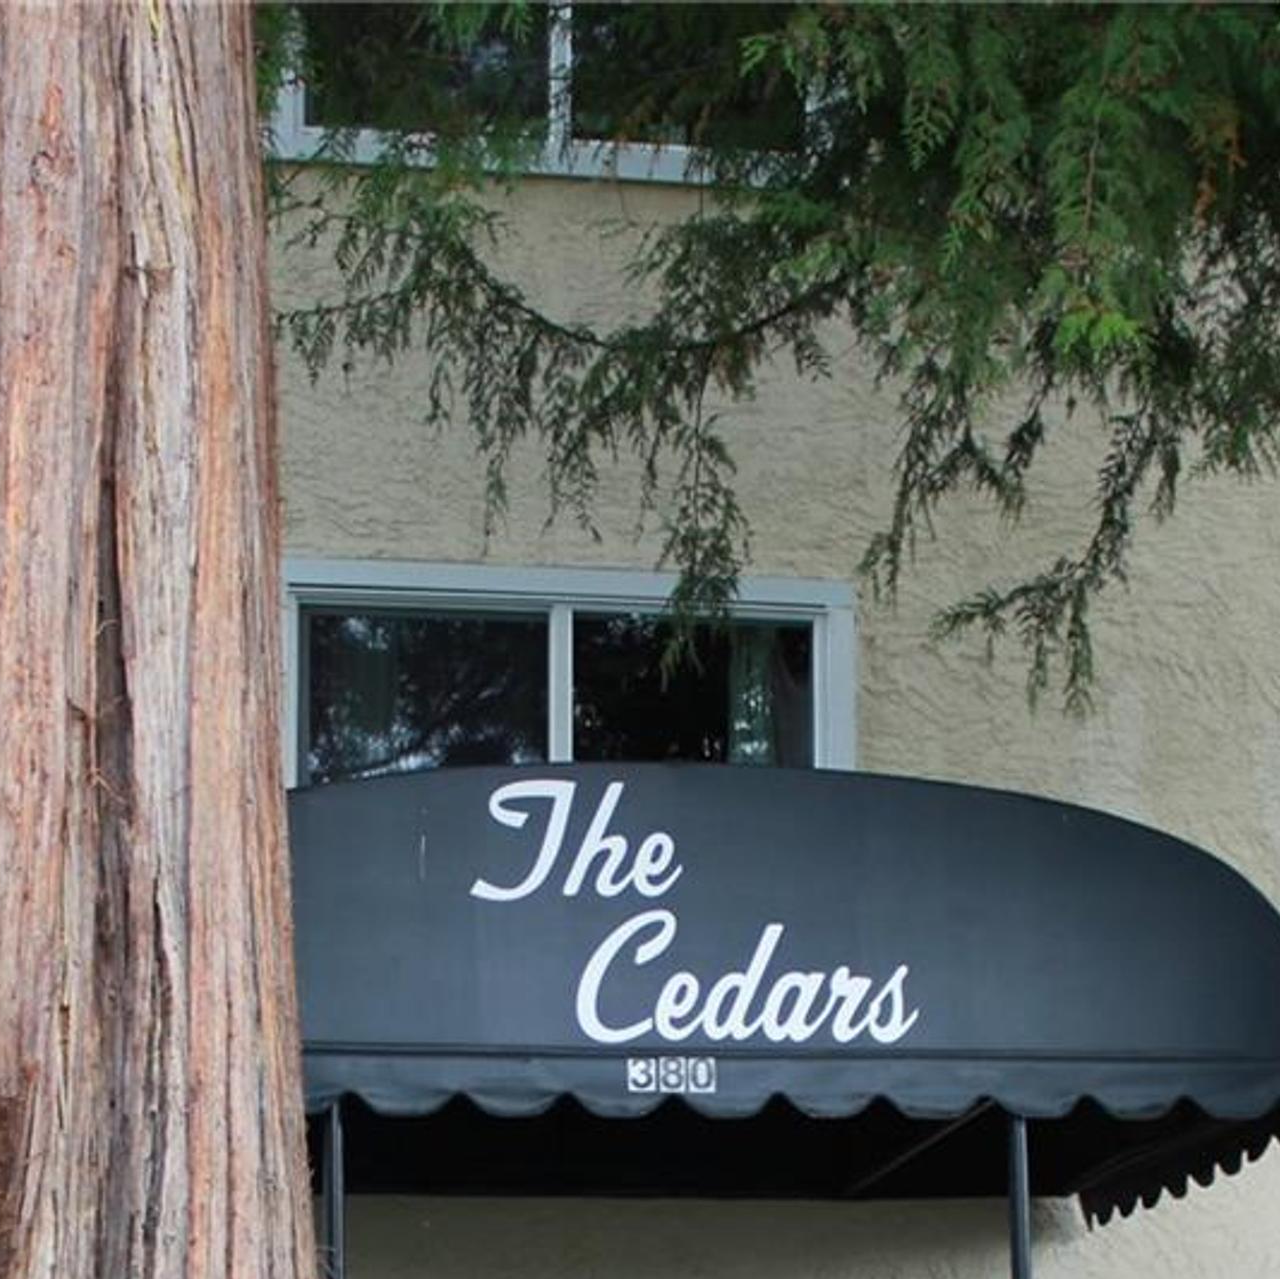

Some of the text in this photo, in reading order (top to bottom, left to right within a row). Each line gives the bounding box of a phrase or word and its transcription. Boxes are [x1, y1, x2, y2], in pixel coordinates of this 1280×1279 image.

[469, 779, 683, 901] The
[576, 909, 919, 1044] Cedars
[629, 1056, 715, 1092] 380
